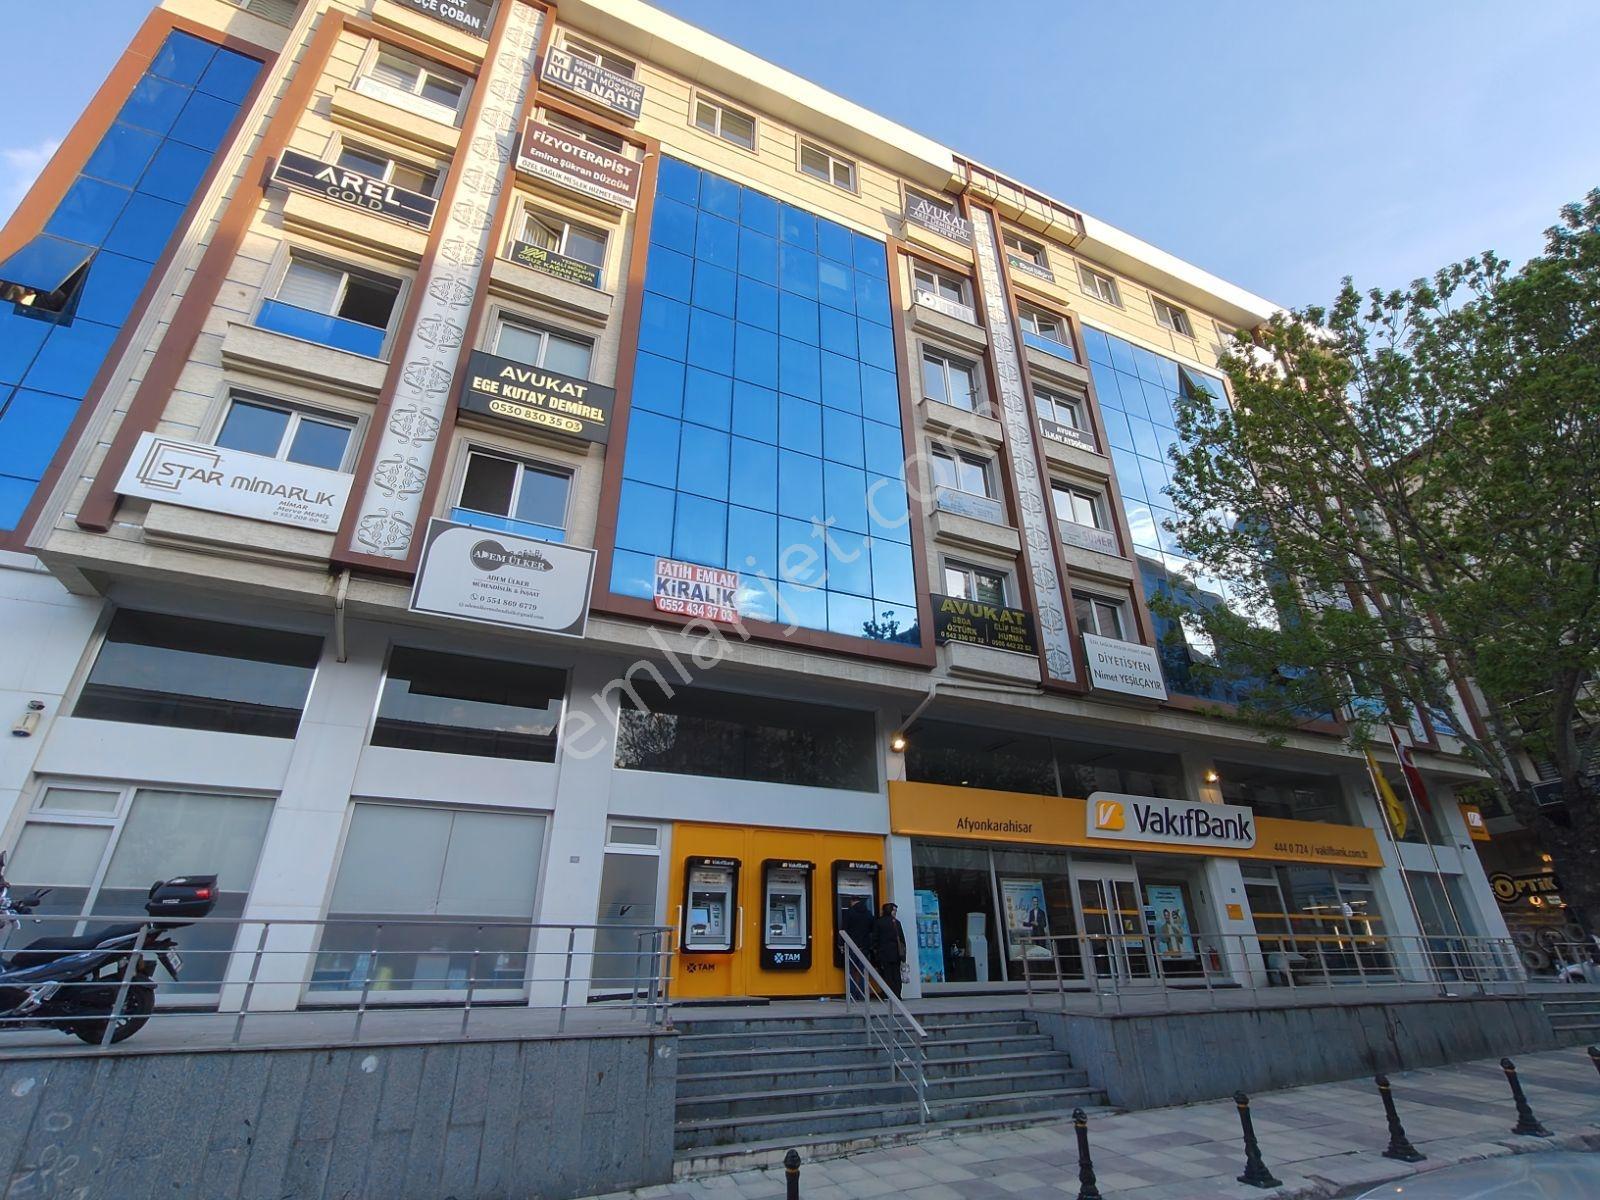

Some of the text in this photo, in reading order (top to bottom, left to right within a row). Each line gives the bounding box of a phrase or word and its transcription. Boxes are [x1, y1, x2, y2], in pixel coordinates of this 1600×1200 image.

[440, 4, 480, 29] ÇOBAN
[547, 64, 587, 89] NUR
[591, 82, 639, 111] NART
[600, 76, 641, 100] MÜŞAVİR
[530, 147, 559, 164] Emine
[533, 129, 632, 177] FİZYOTERAPİST
[314, 166, 401, 207] AREL
[326, 186, 383, 211] GOLD
[916, 200, 967, 229] AVUKAT
[573, 271, 593, 282] KAYA
[500, 366, 588, 399] AVUKAT
[472, 376, 605, 422] EGE KUTAY DEMİREL
[491, 401, 581, 431] 0530 830 35 03
[158, 462, 224, 487] STAR
[278, 500, 309, 511] MİMAR
[473, 550, 545, 571] ADEM ÜLKER
[486, 574, 530, 587] ADEM ÜLKER
[696, 568, 735, 589] EMLAK
[660, 598, 733, 621] 0552 434 37 03
[941, 599, 1025, 625] AVUKAT
[1097, 652, 1151, 673] DİYETİSYEN
[1094, 669, 1118, 682] Nimet
[956, 816, 1033, 833] Afyonkarahisar
[1133, 803, 1253, 841] VakıfBank
[1274, 842, 1288, 852] 444
[698, 963, 715, 971] TAM
[783, 953, 800, 961] TAM
